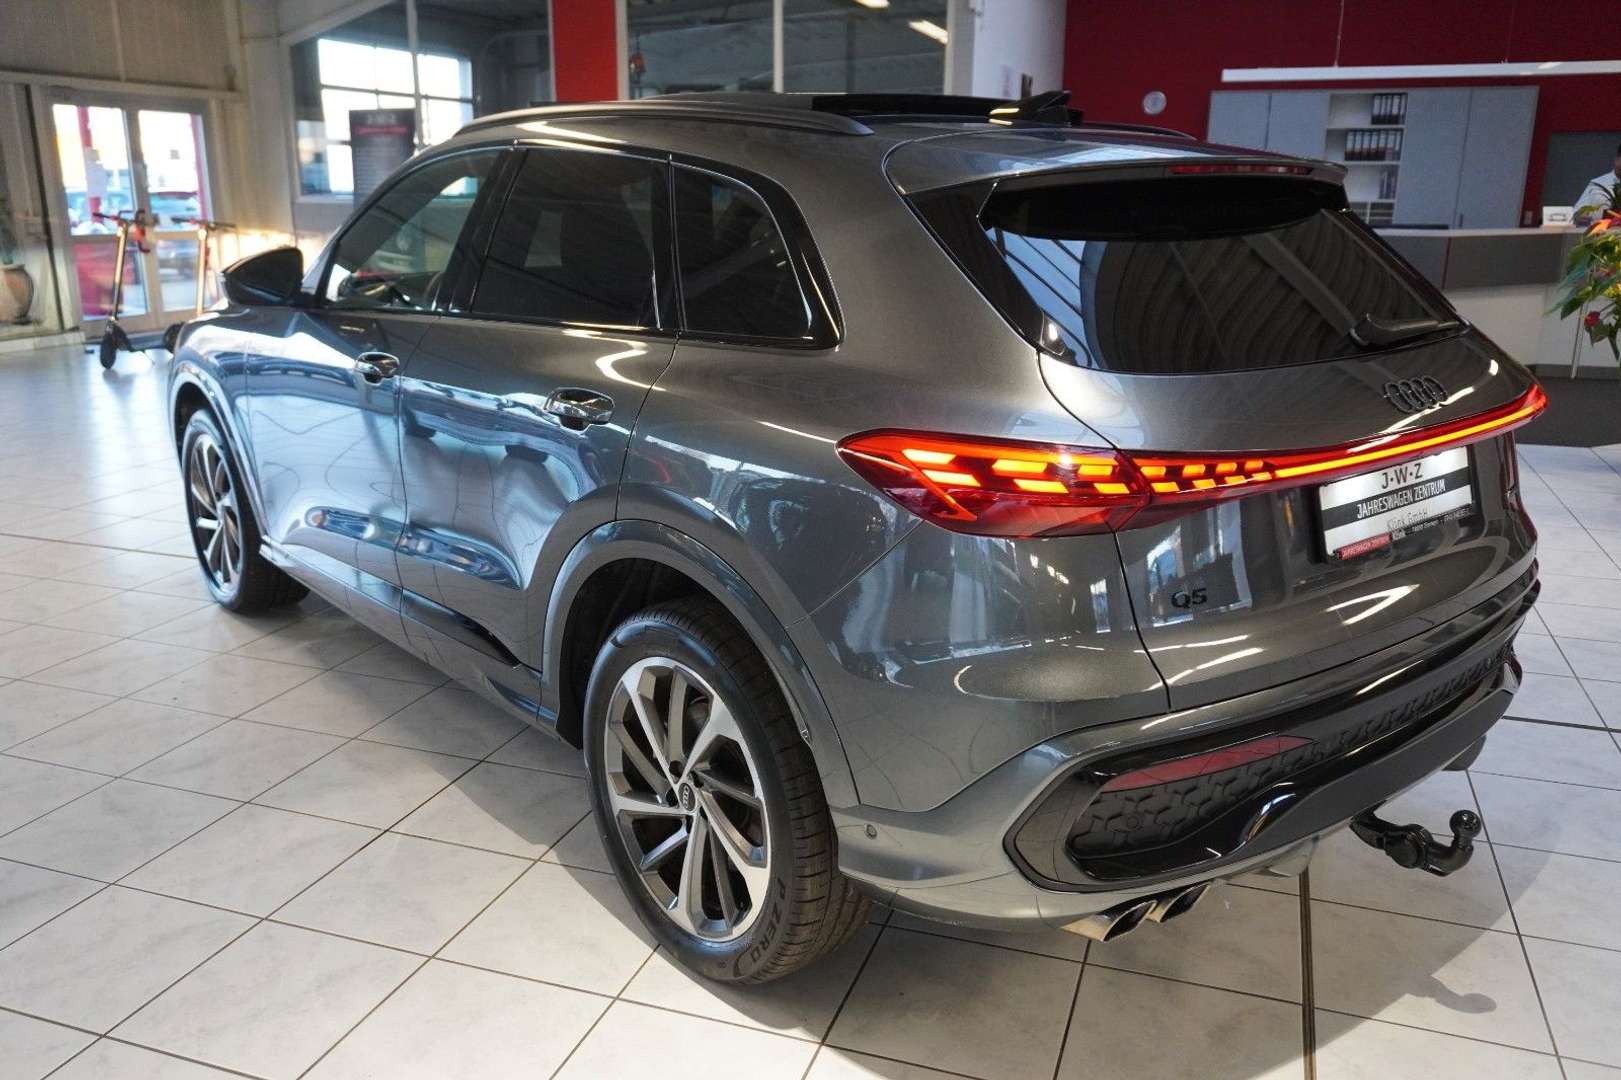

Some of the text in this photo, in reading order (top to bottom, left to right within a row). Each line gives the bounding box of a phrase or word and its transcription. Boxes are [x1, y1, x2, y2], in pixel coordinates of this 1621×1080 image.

[1356, 479, 1446, 519] JAHRESWAGEN ZENTRUM
[1171, 588, 1207, 608] Q5
[751, 900, 781, 962] ZERO
